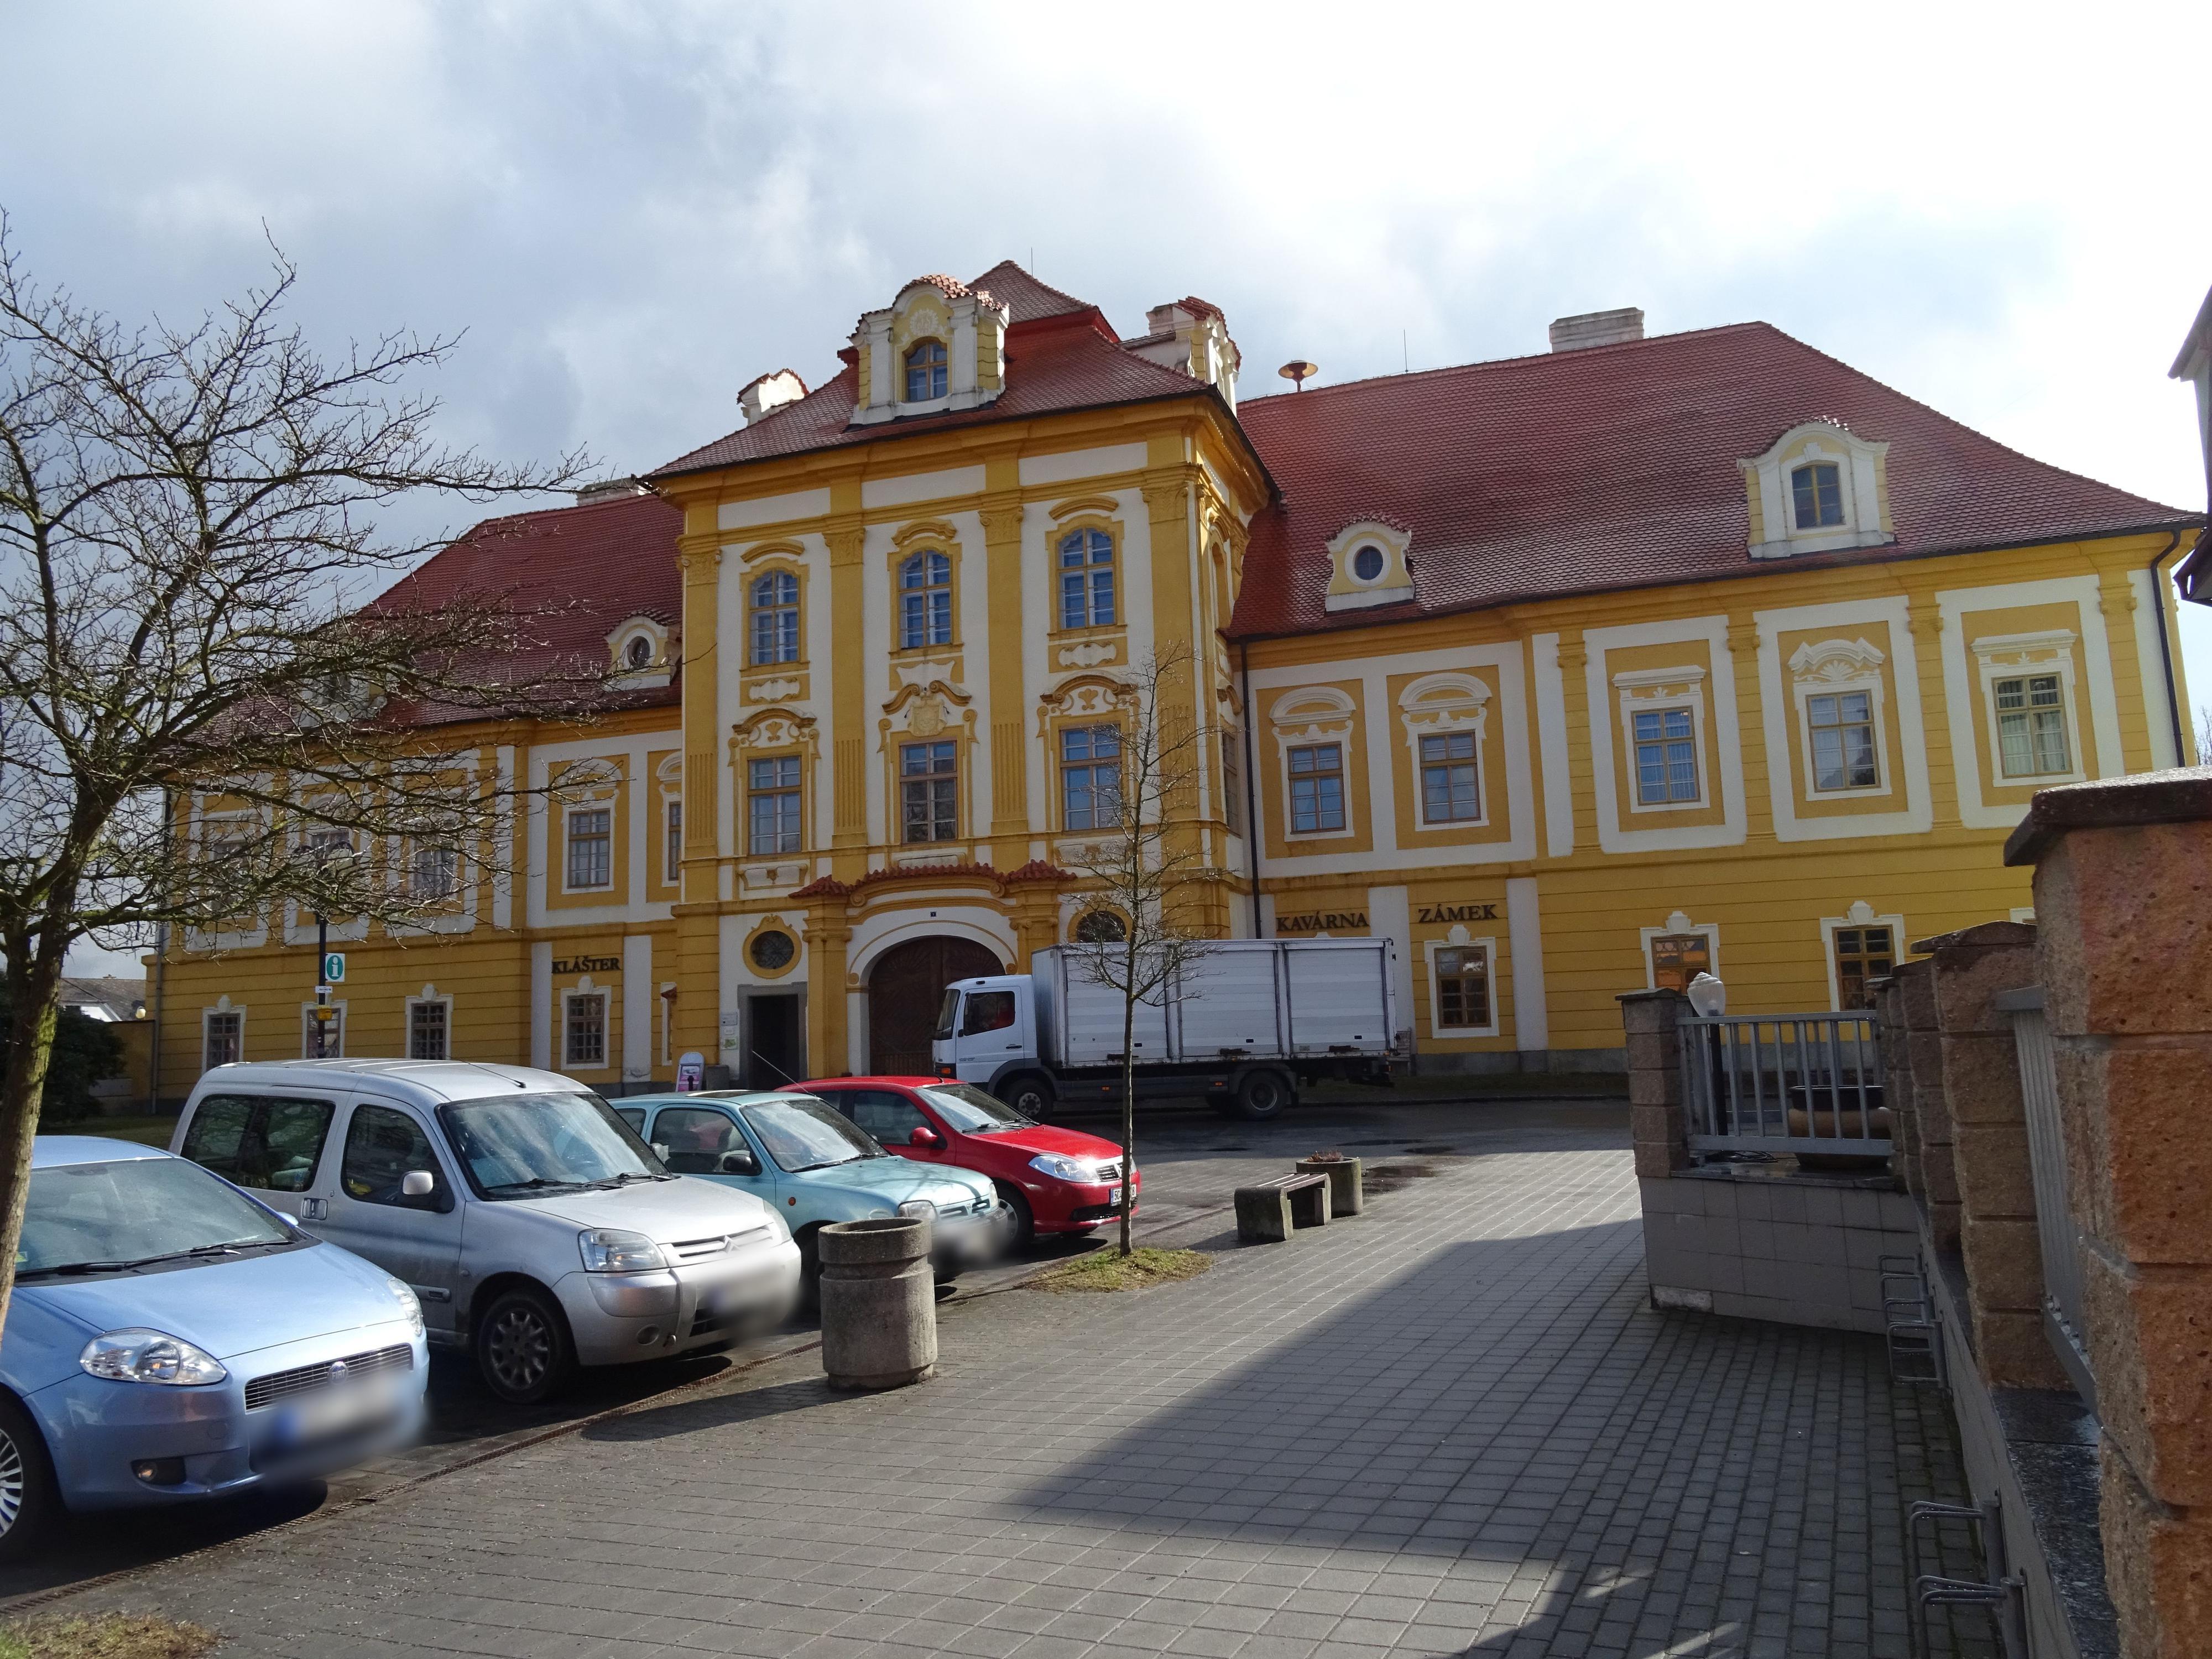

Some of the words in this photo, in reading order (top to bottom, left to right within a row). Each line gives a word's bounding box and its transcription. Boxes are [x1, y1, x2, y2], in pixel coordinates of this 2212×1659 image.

[1276, 911, 1370, 931] KAVÁRNA
[1418, 904, 1498, 923] ZÁMEK
[552, 956, 622, 974] KLÁŠTER
